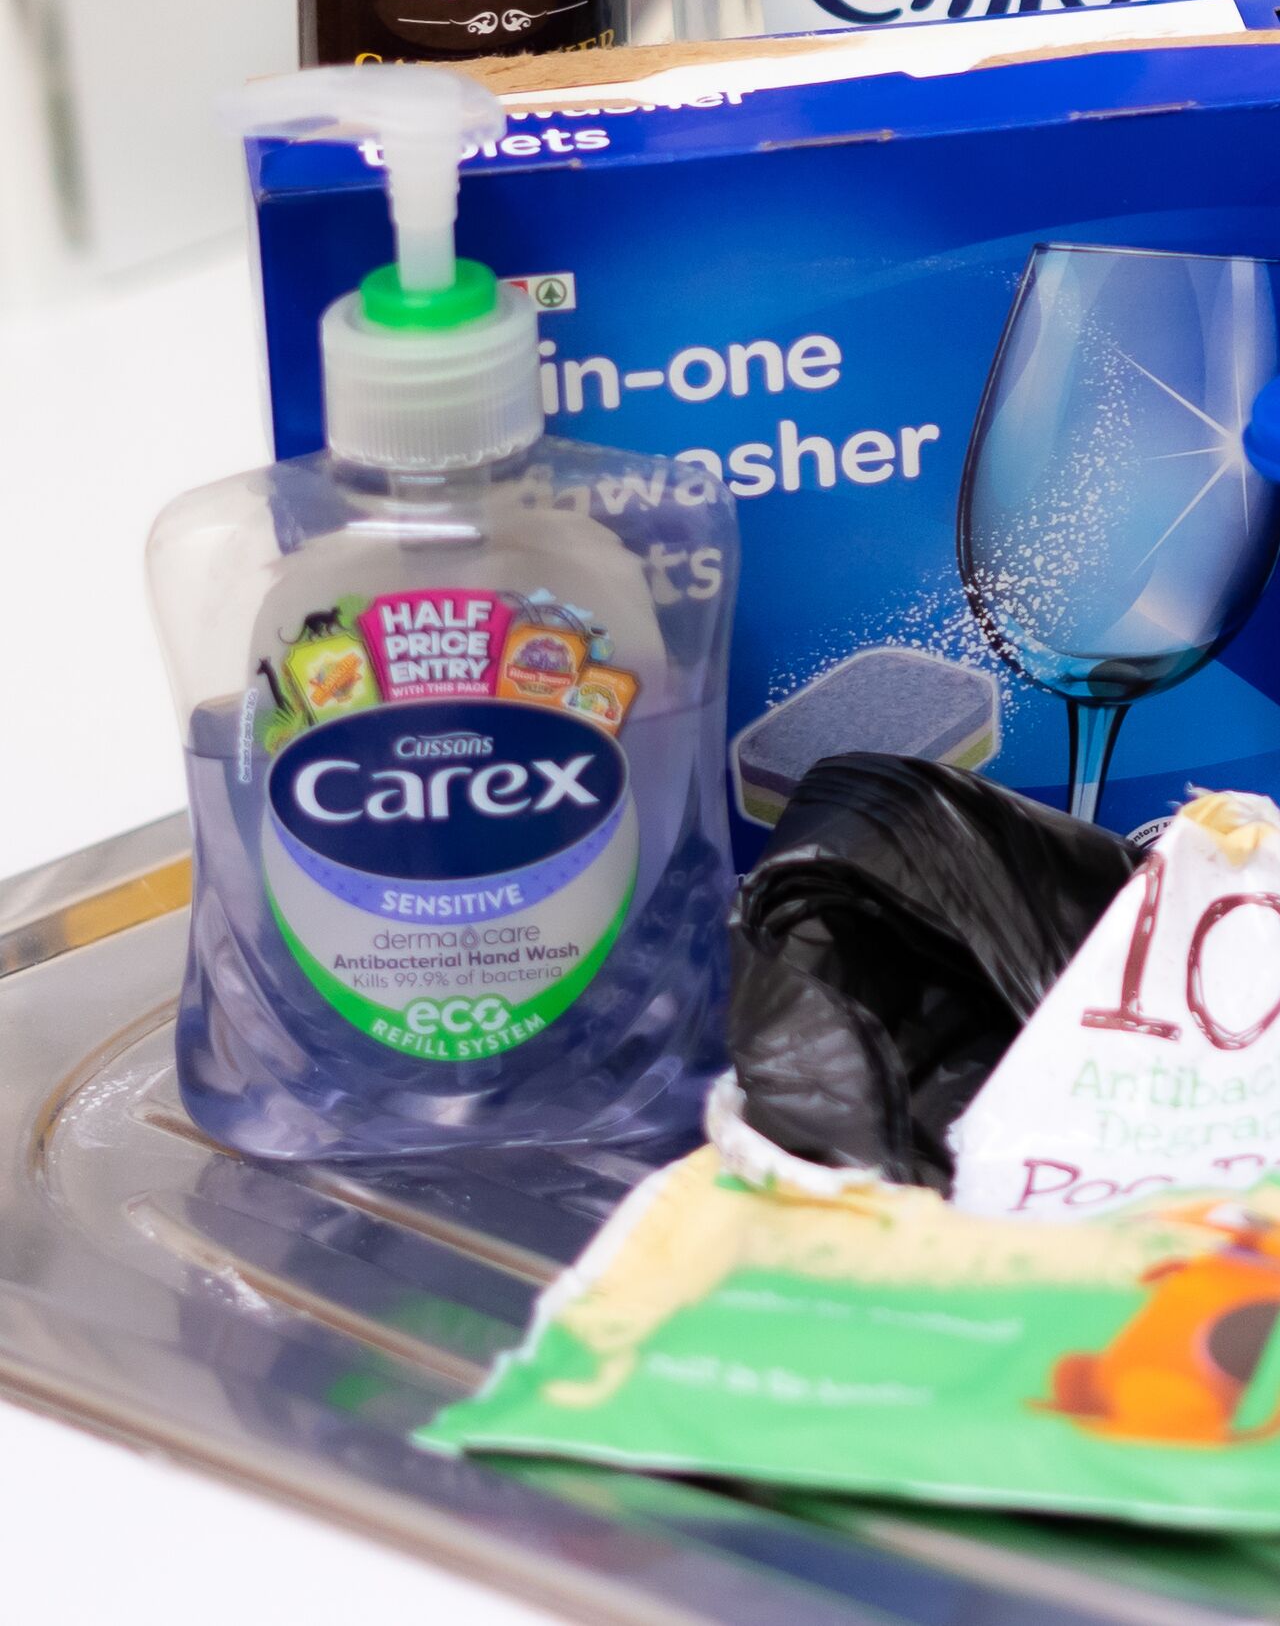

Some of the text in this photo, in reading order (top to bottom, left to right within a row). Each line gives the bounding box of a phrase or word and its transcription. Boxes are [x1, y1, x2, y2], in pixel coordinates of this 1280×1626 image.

[381, 600, 492, 633] HALF
[385, 631, 490, 660] PRICE
[389, 658, 490, 684] ENTRY
[392, 682, 489, 697] WITH THIS PACK
[396, 731, 493, 758] Cussons
[294, 754, 600, 822] Carex
[381, 884, 524, 917] SENSITIVE
[373, 925, 540, 951] derma care
[334, 942, 580, 970] Antibacterial Hand Wash
[353, 966, 563, 989] Kills 99.9% of bacteria
[407, 998, 511, 1035] eco
[372, 1013, 546, 1057] REFILL SYSTEM
